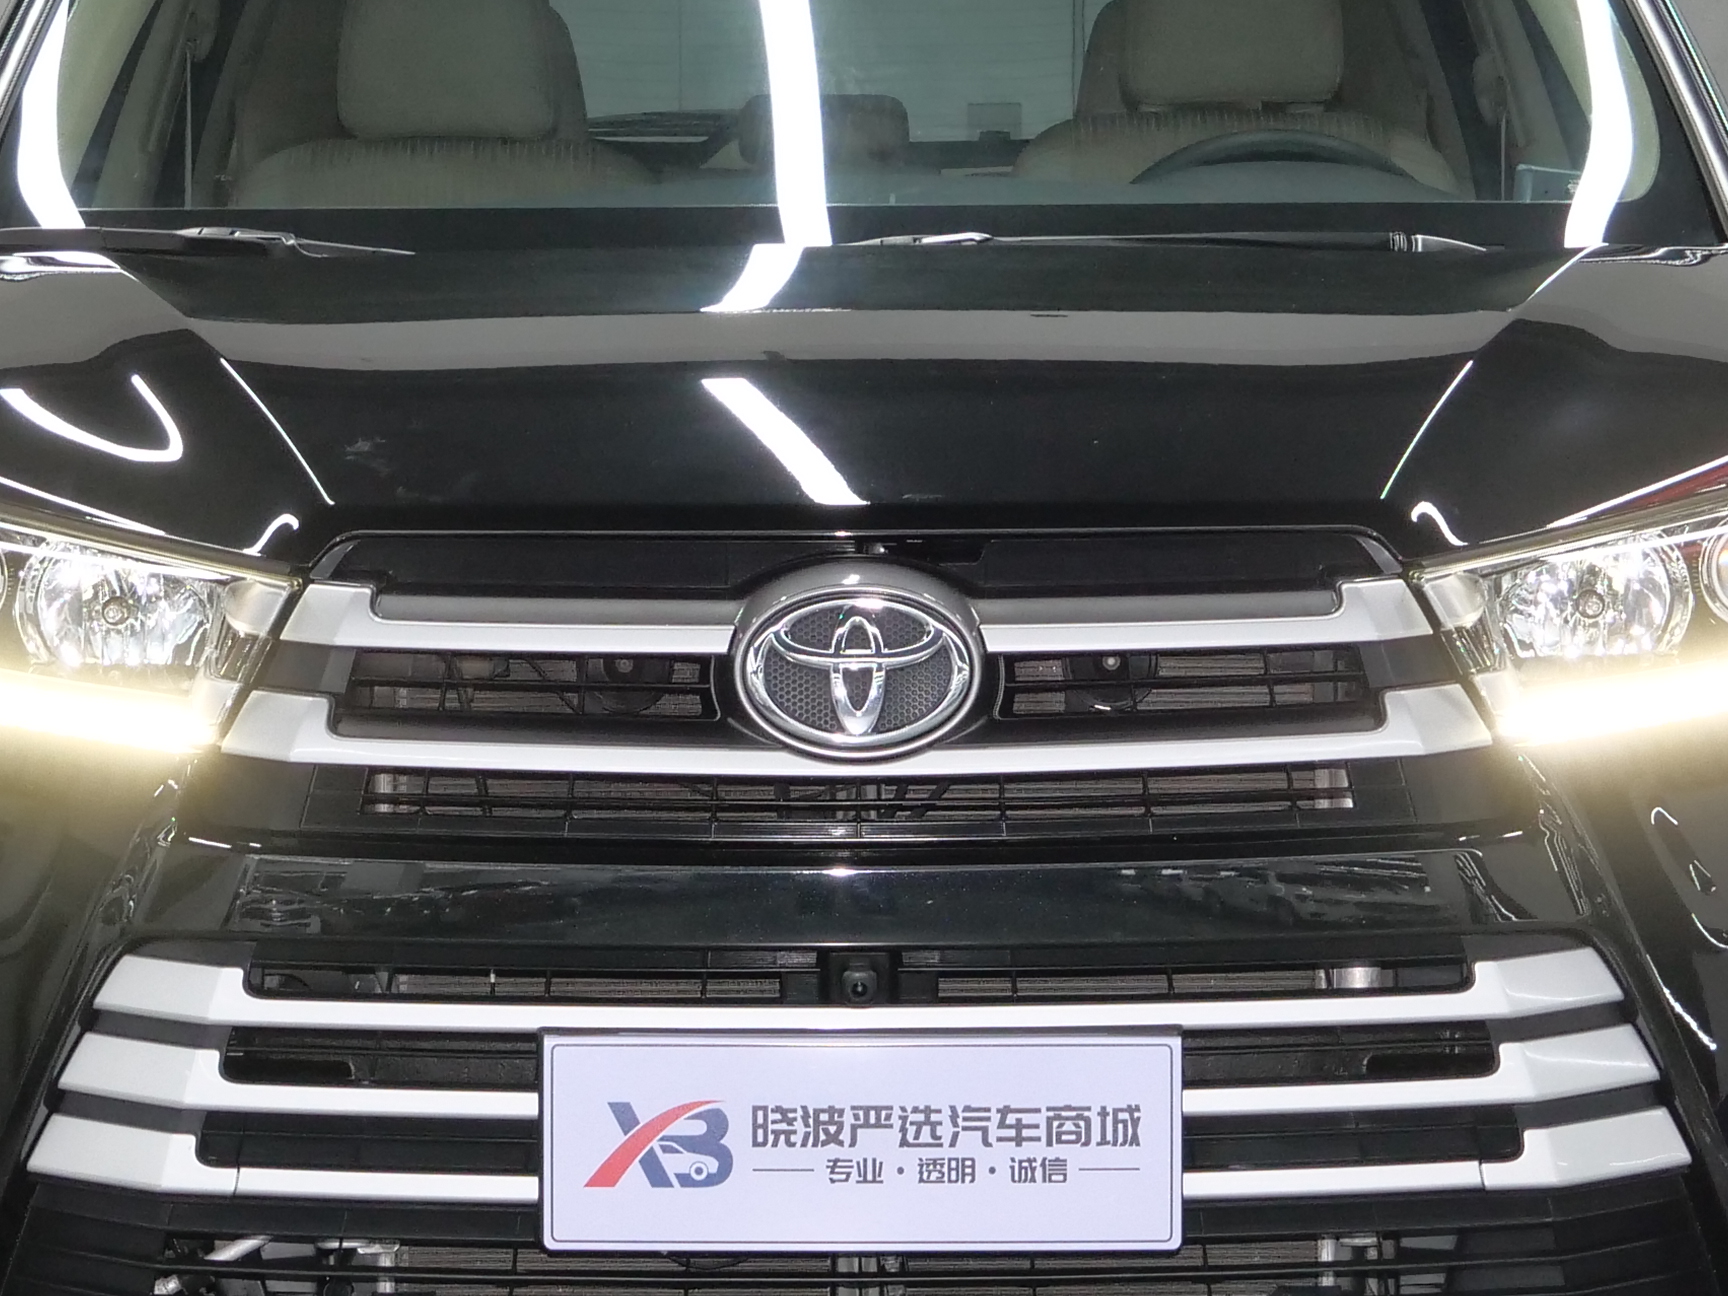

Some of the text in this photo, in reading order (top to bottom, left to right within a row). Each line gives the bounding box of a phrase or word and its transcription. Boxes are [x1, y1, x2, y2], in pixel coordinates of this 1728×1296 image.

[751, 1104, 1141, 1148] 晓波严选汽车商城
